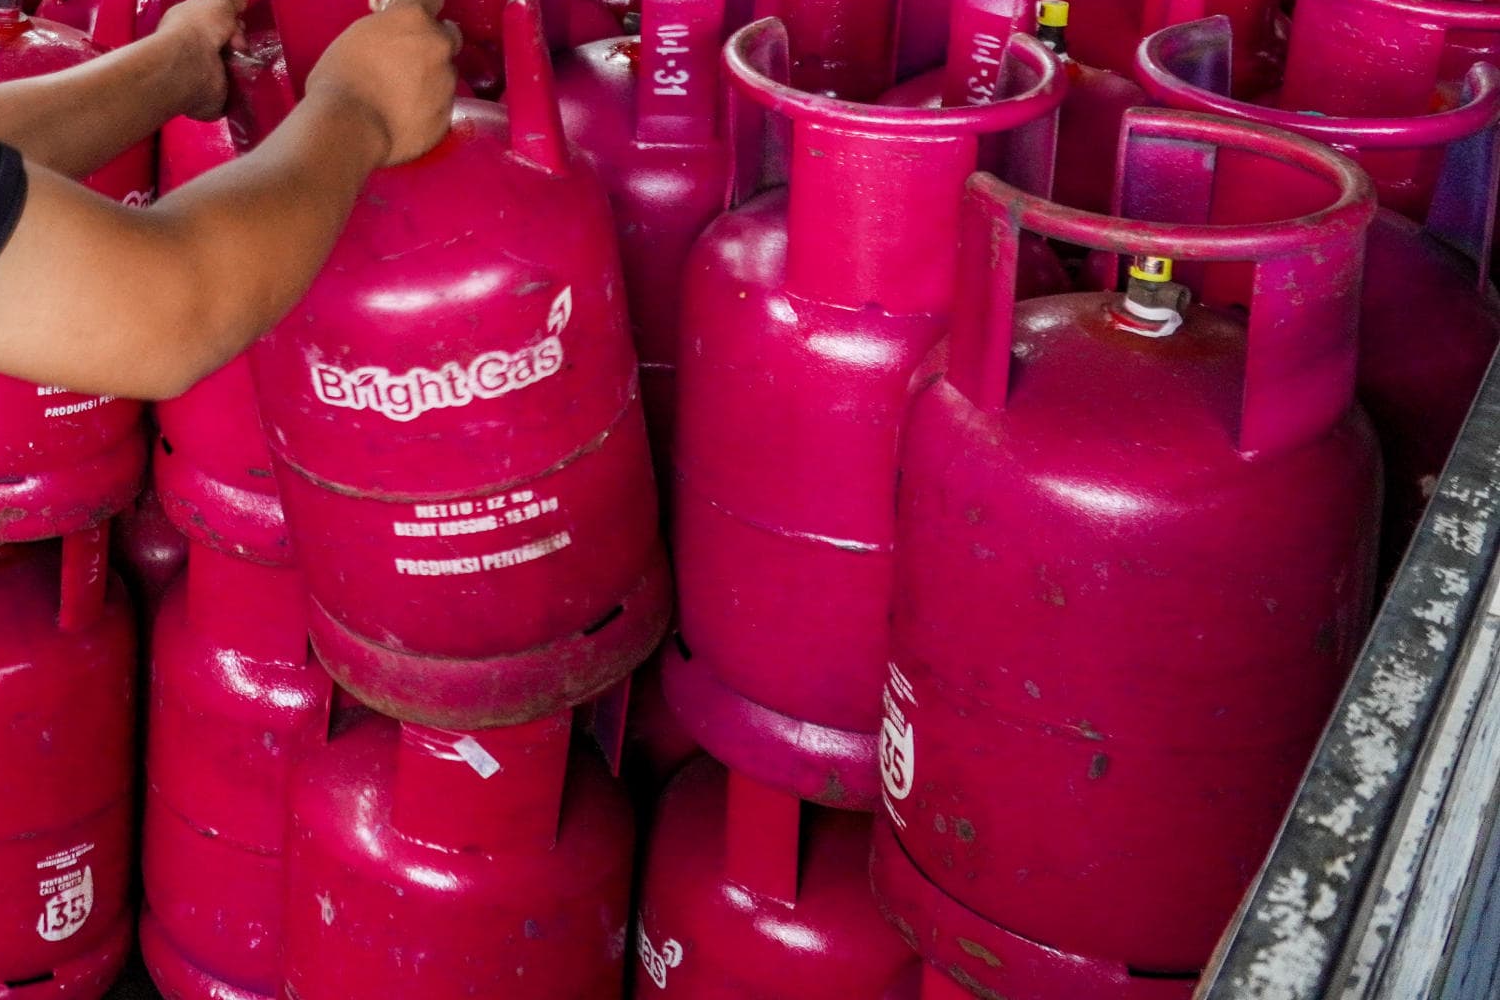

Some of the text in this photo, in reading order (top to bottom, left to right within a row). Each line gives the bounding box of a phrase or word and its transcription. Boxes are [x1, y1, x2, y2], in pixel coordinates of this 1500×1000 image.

[44, 399, 98, 418] PRODUKSI
[414, 502, 474, 519] NETTO
[393, 521, 437, 537] BERAT
[395, 556, 481, 577] PRODUKSI
[882, 727, 905, 791] 35
[39, 876, 83, 897] CALL CENTER
[40, 869, 82, 889] PERTAMINA
[43, 894, 86, 933] 135
